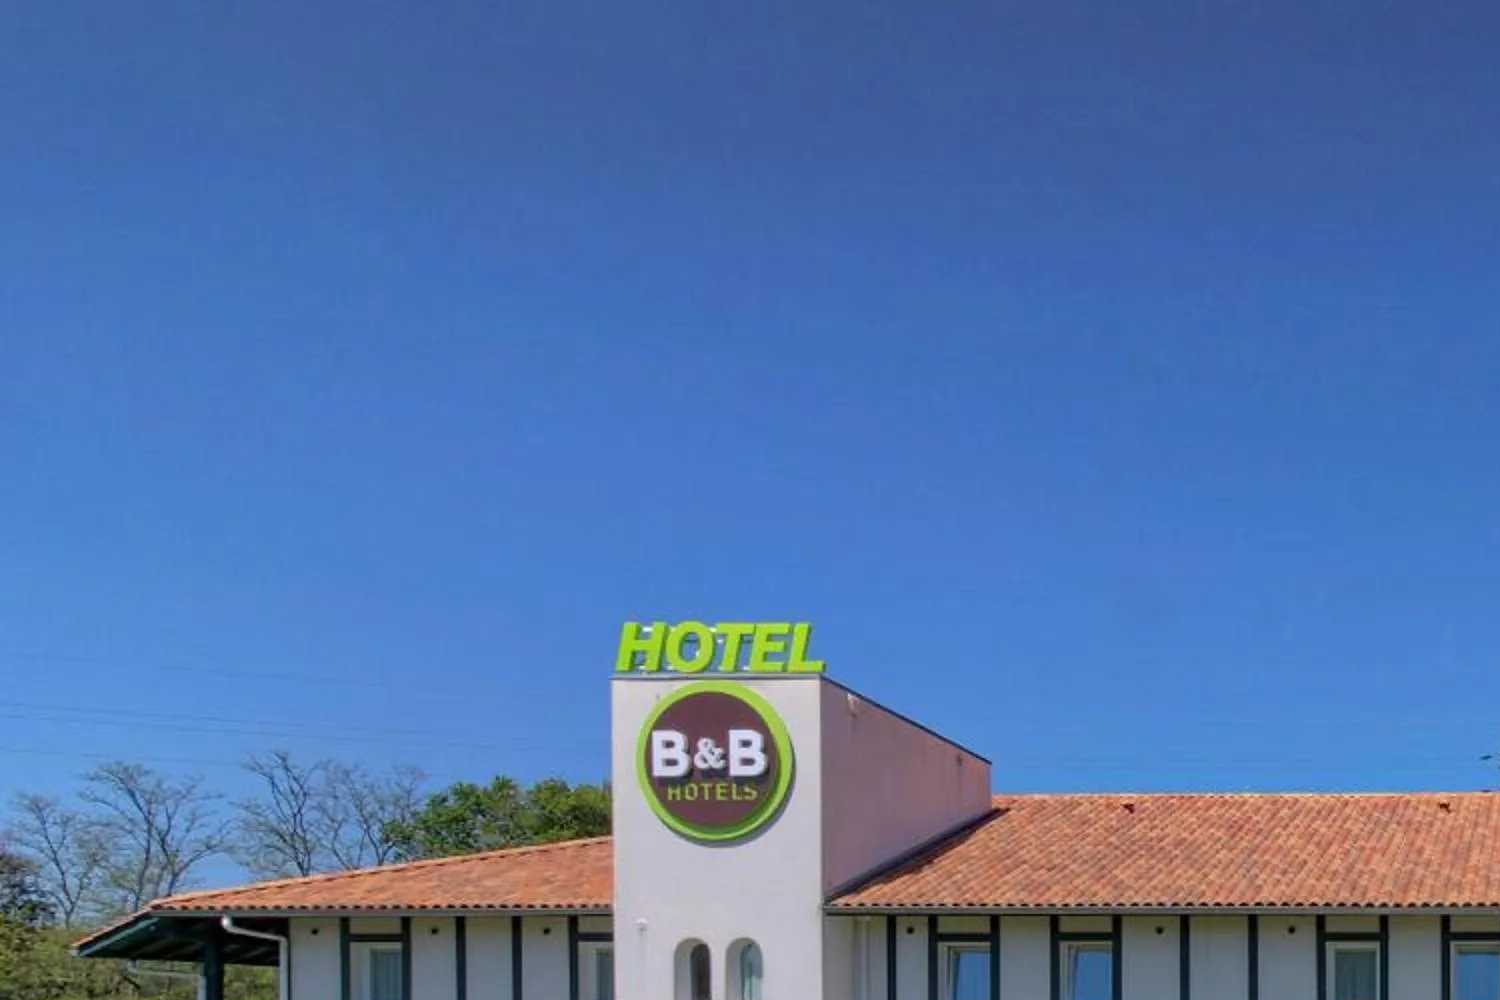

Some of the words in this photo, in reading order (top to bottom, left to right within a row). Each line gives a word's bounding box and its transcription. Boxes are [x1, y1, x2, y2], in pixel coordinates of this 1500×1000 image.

[616, 621, 826, 673] HOTEL
[651, 729, 769, 777] B&B
[667, 783, 758, 801] HOTELS
